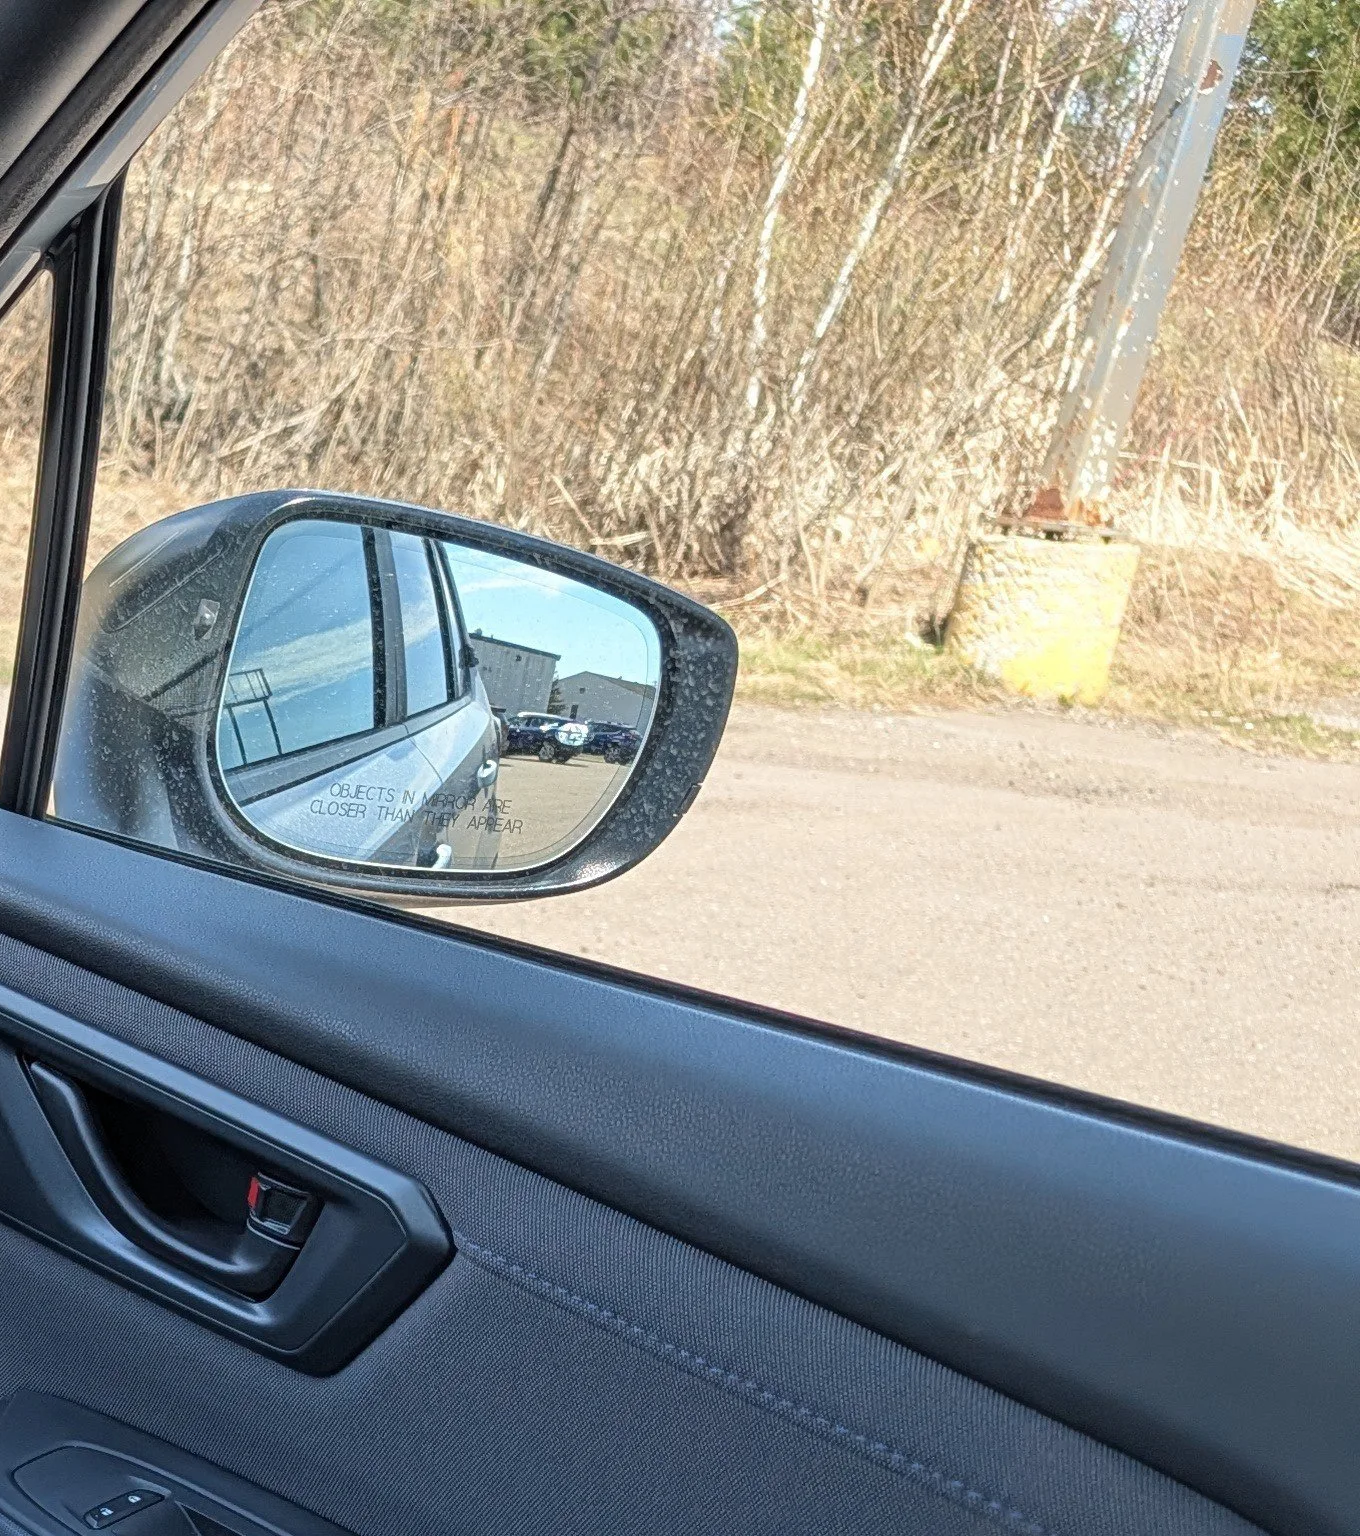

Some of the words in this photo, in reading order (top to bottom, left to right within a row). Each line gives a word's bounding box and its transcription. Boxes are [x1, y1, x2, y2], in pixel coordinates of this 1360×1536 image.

[330, 782, 395, 802] OBJECTS
[402, 790, 415, 804] IN
[422, 791, 476, 811] MIRROR
[482, 799, 513, 814] ARE
[309, 799, 367, 819] CLOSER
[377, 805, 415, 823] THAN
[424, 810, 460, 828] THEY
[466, 816, 523, 834] APPEAR
